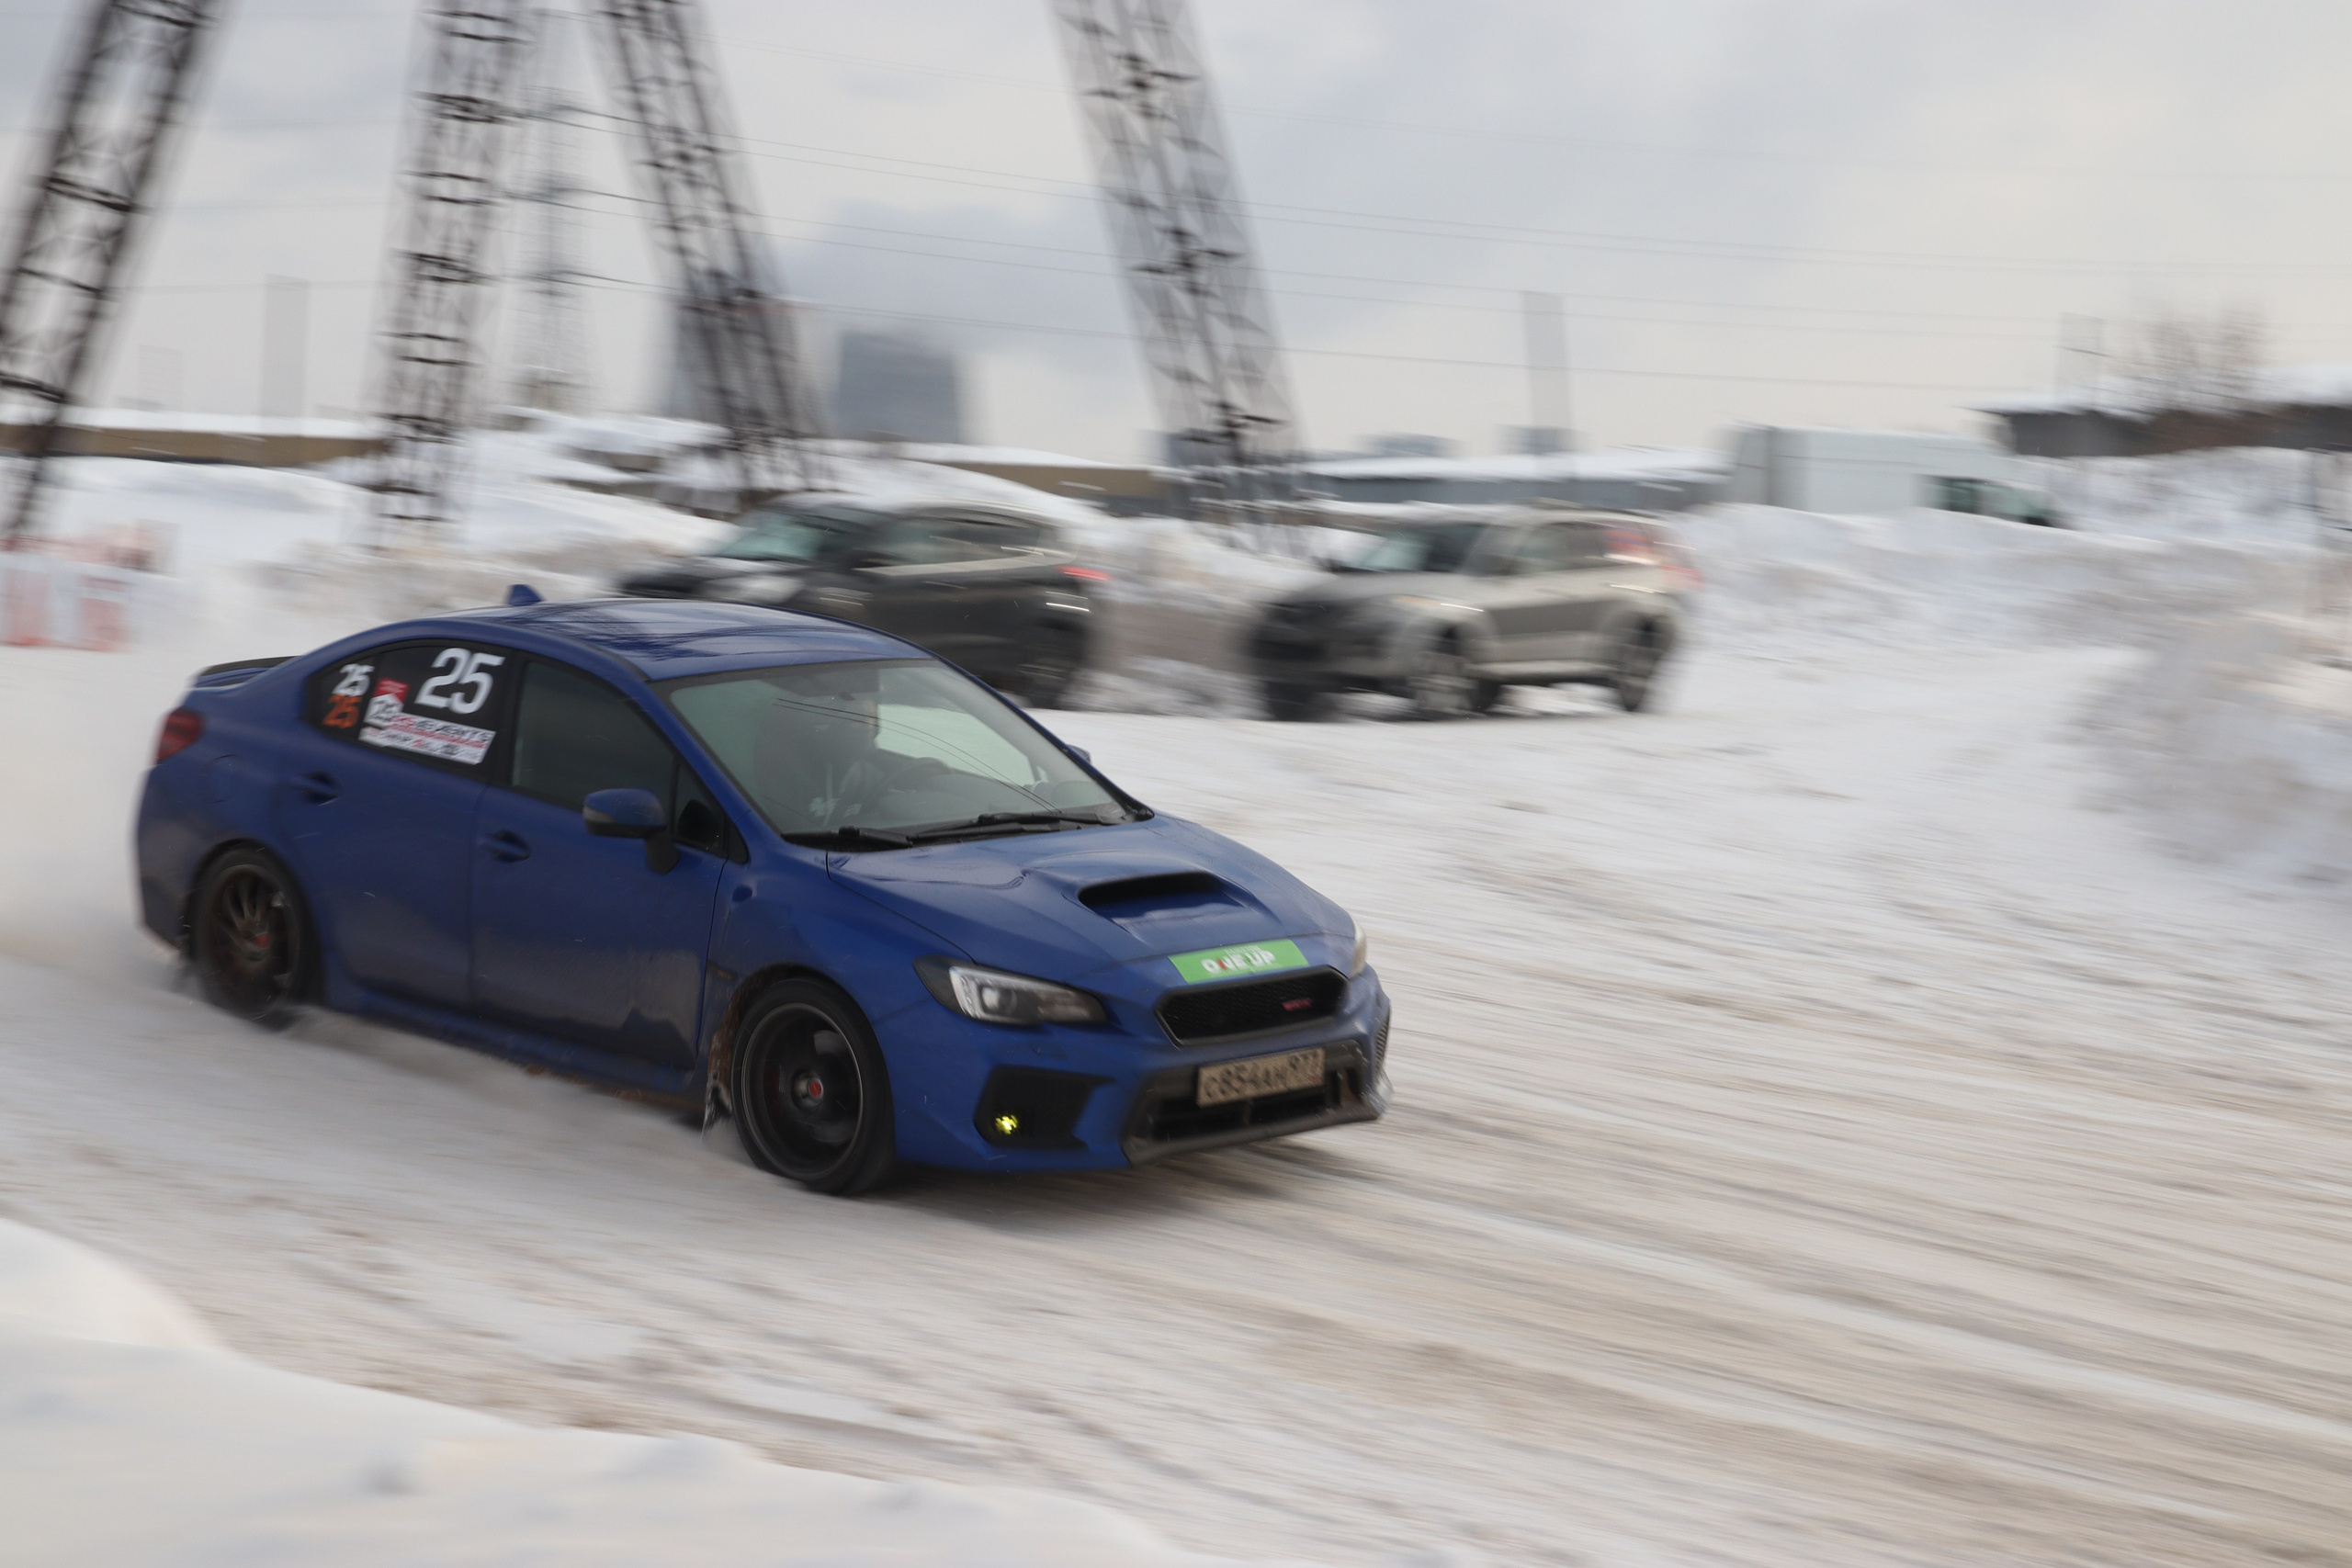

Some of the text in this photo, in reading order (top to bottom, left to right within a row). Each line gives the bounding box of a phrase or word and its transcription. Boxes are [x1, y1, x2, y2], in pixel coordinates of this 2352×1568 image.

[332, 663, 375, 696] 25
[415, 648, 505, 714] 25
[322, 694, 363, 728] 25
